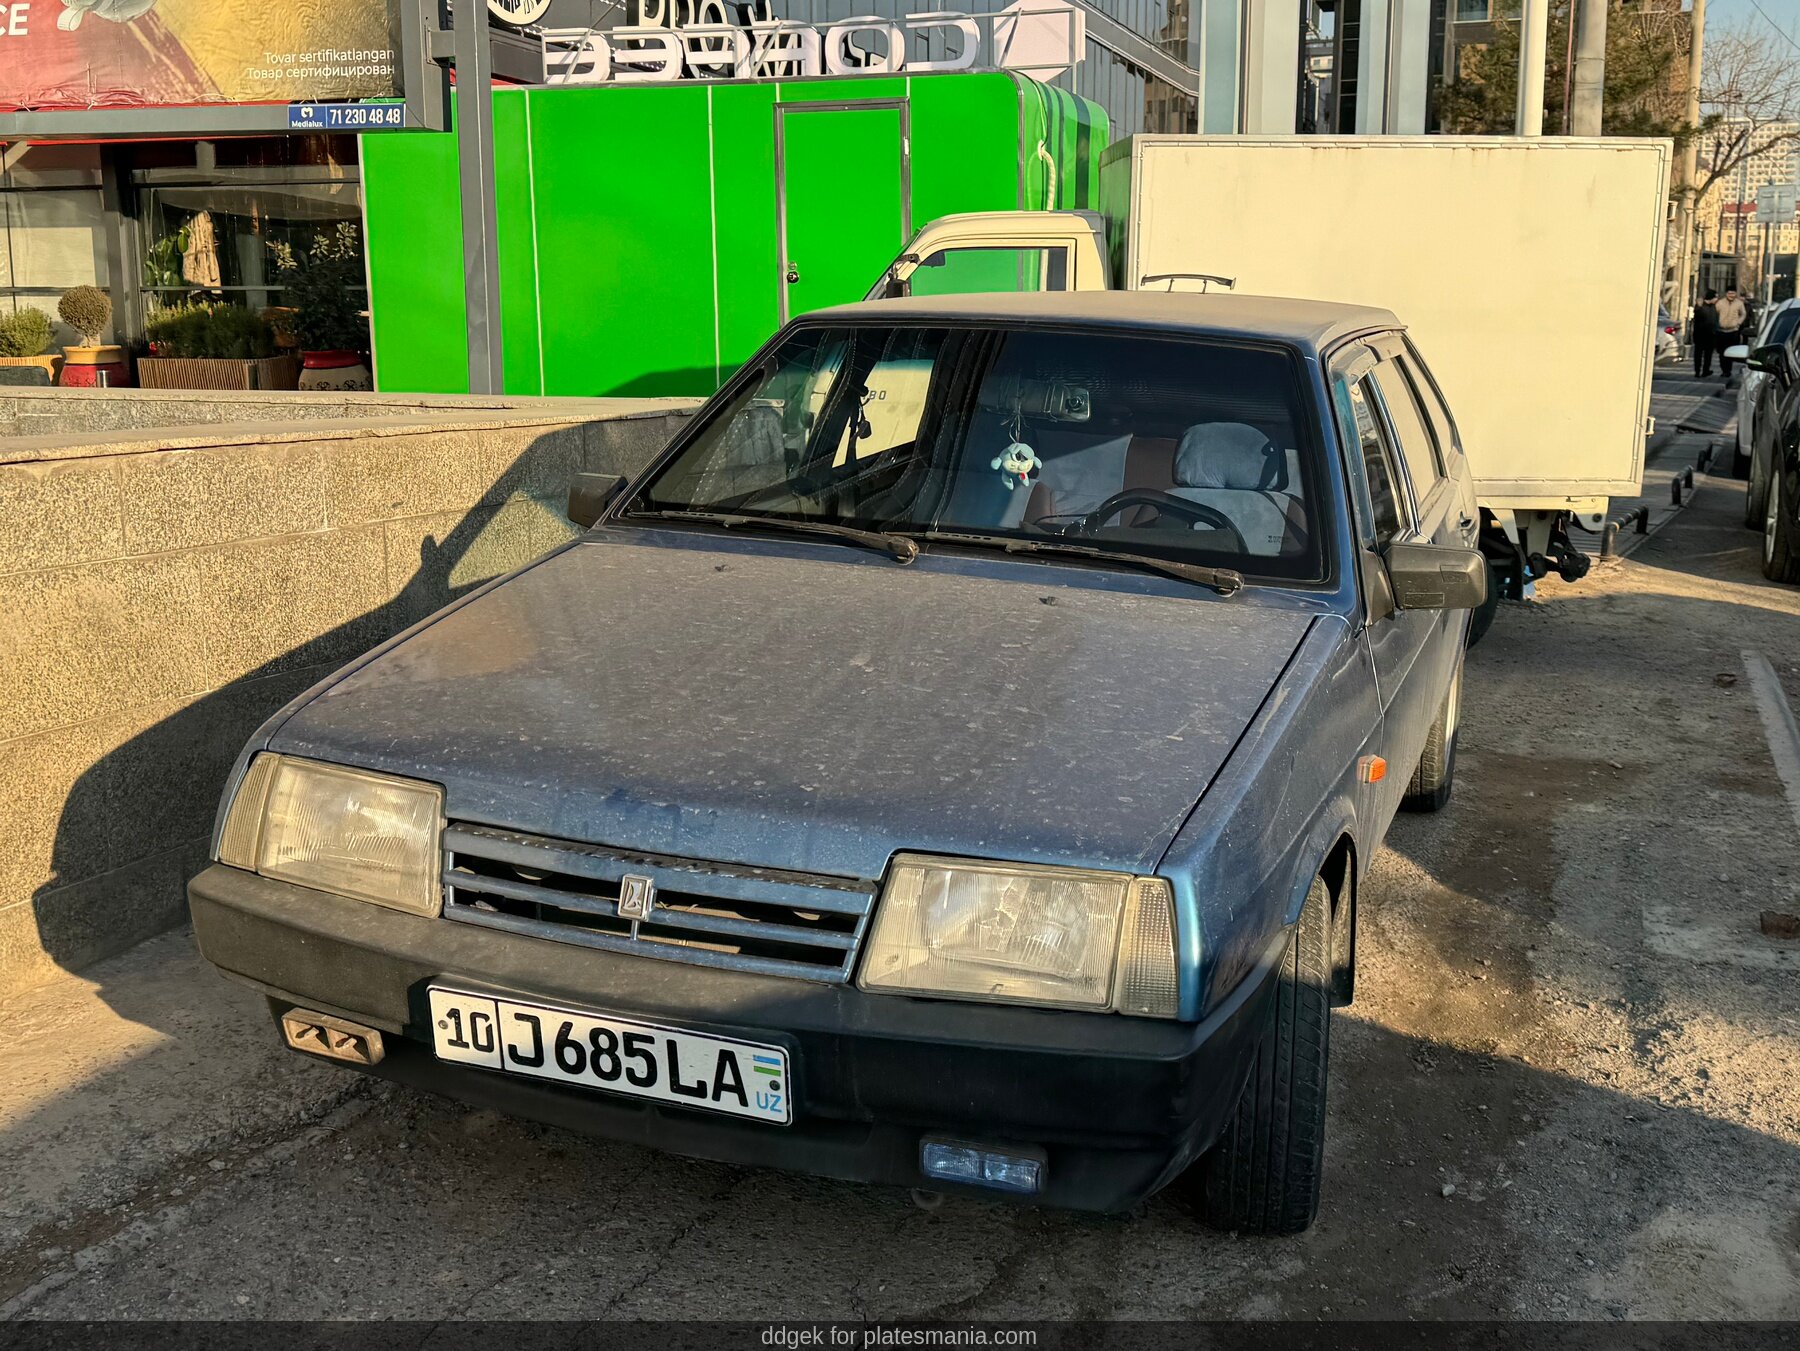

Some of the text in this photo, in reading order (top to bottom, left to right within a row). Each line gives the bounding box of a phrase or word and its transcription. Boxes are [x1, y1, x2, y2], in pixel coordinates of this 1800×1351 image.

[265, 48, 395, 64] Tovar sertifikatlangan
[248, 64, 395, 80] Товар сертифицирован
[291, 120, 323, 128] Medialux
[330, 108, 400, 124] 71 230 48 48
[447, 1008, 494, 1053] 10
[756, 1091, 783, 1113] UZ
